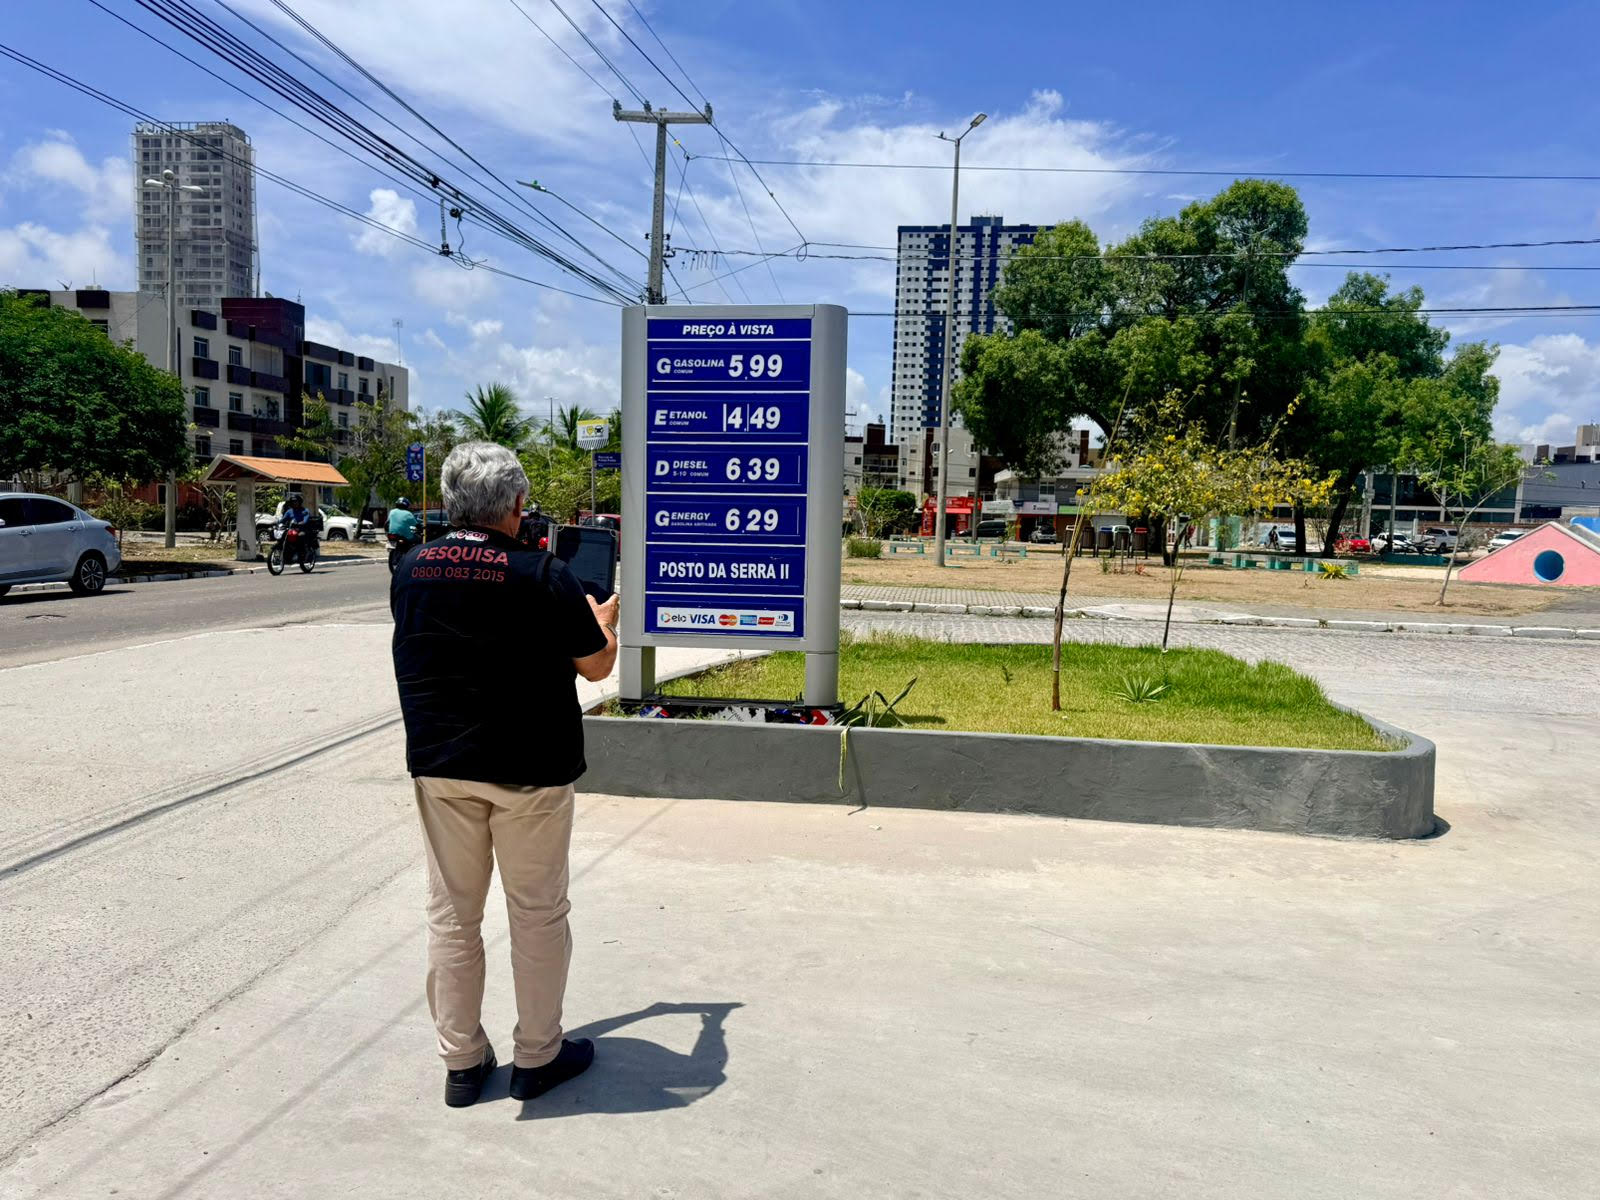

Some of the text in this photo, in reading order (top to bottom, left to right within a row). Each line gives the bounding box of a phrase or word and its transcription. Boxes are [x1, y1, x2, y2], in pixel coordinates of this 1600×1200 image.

[682, 322, 774, 338] PREÇO À VISTA
[656, 357, 672, 374] G
[673, 359, 725, 368] GASOLINA
[654, 409, 668, 426] E
[669, 411, 708, 420] ETANOL
[655, 460, 670, 476] D
[672, 461, 708, 469] DIESEL
[655, 510, 670, 527] G
[671, 512, 710, 521] ENERGY
[416, 545, 509, 566] PESQUISA
[411, 566, 505, 582] 0800 083 2015
[659, 562, 790, 579] POSTO DA SERRA II
[689, 614, 716, 624] VISA
